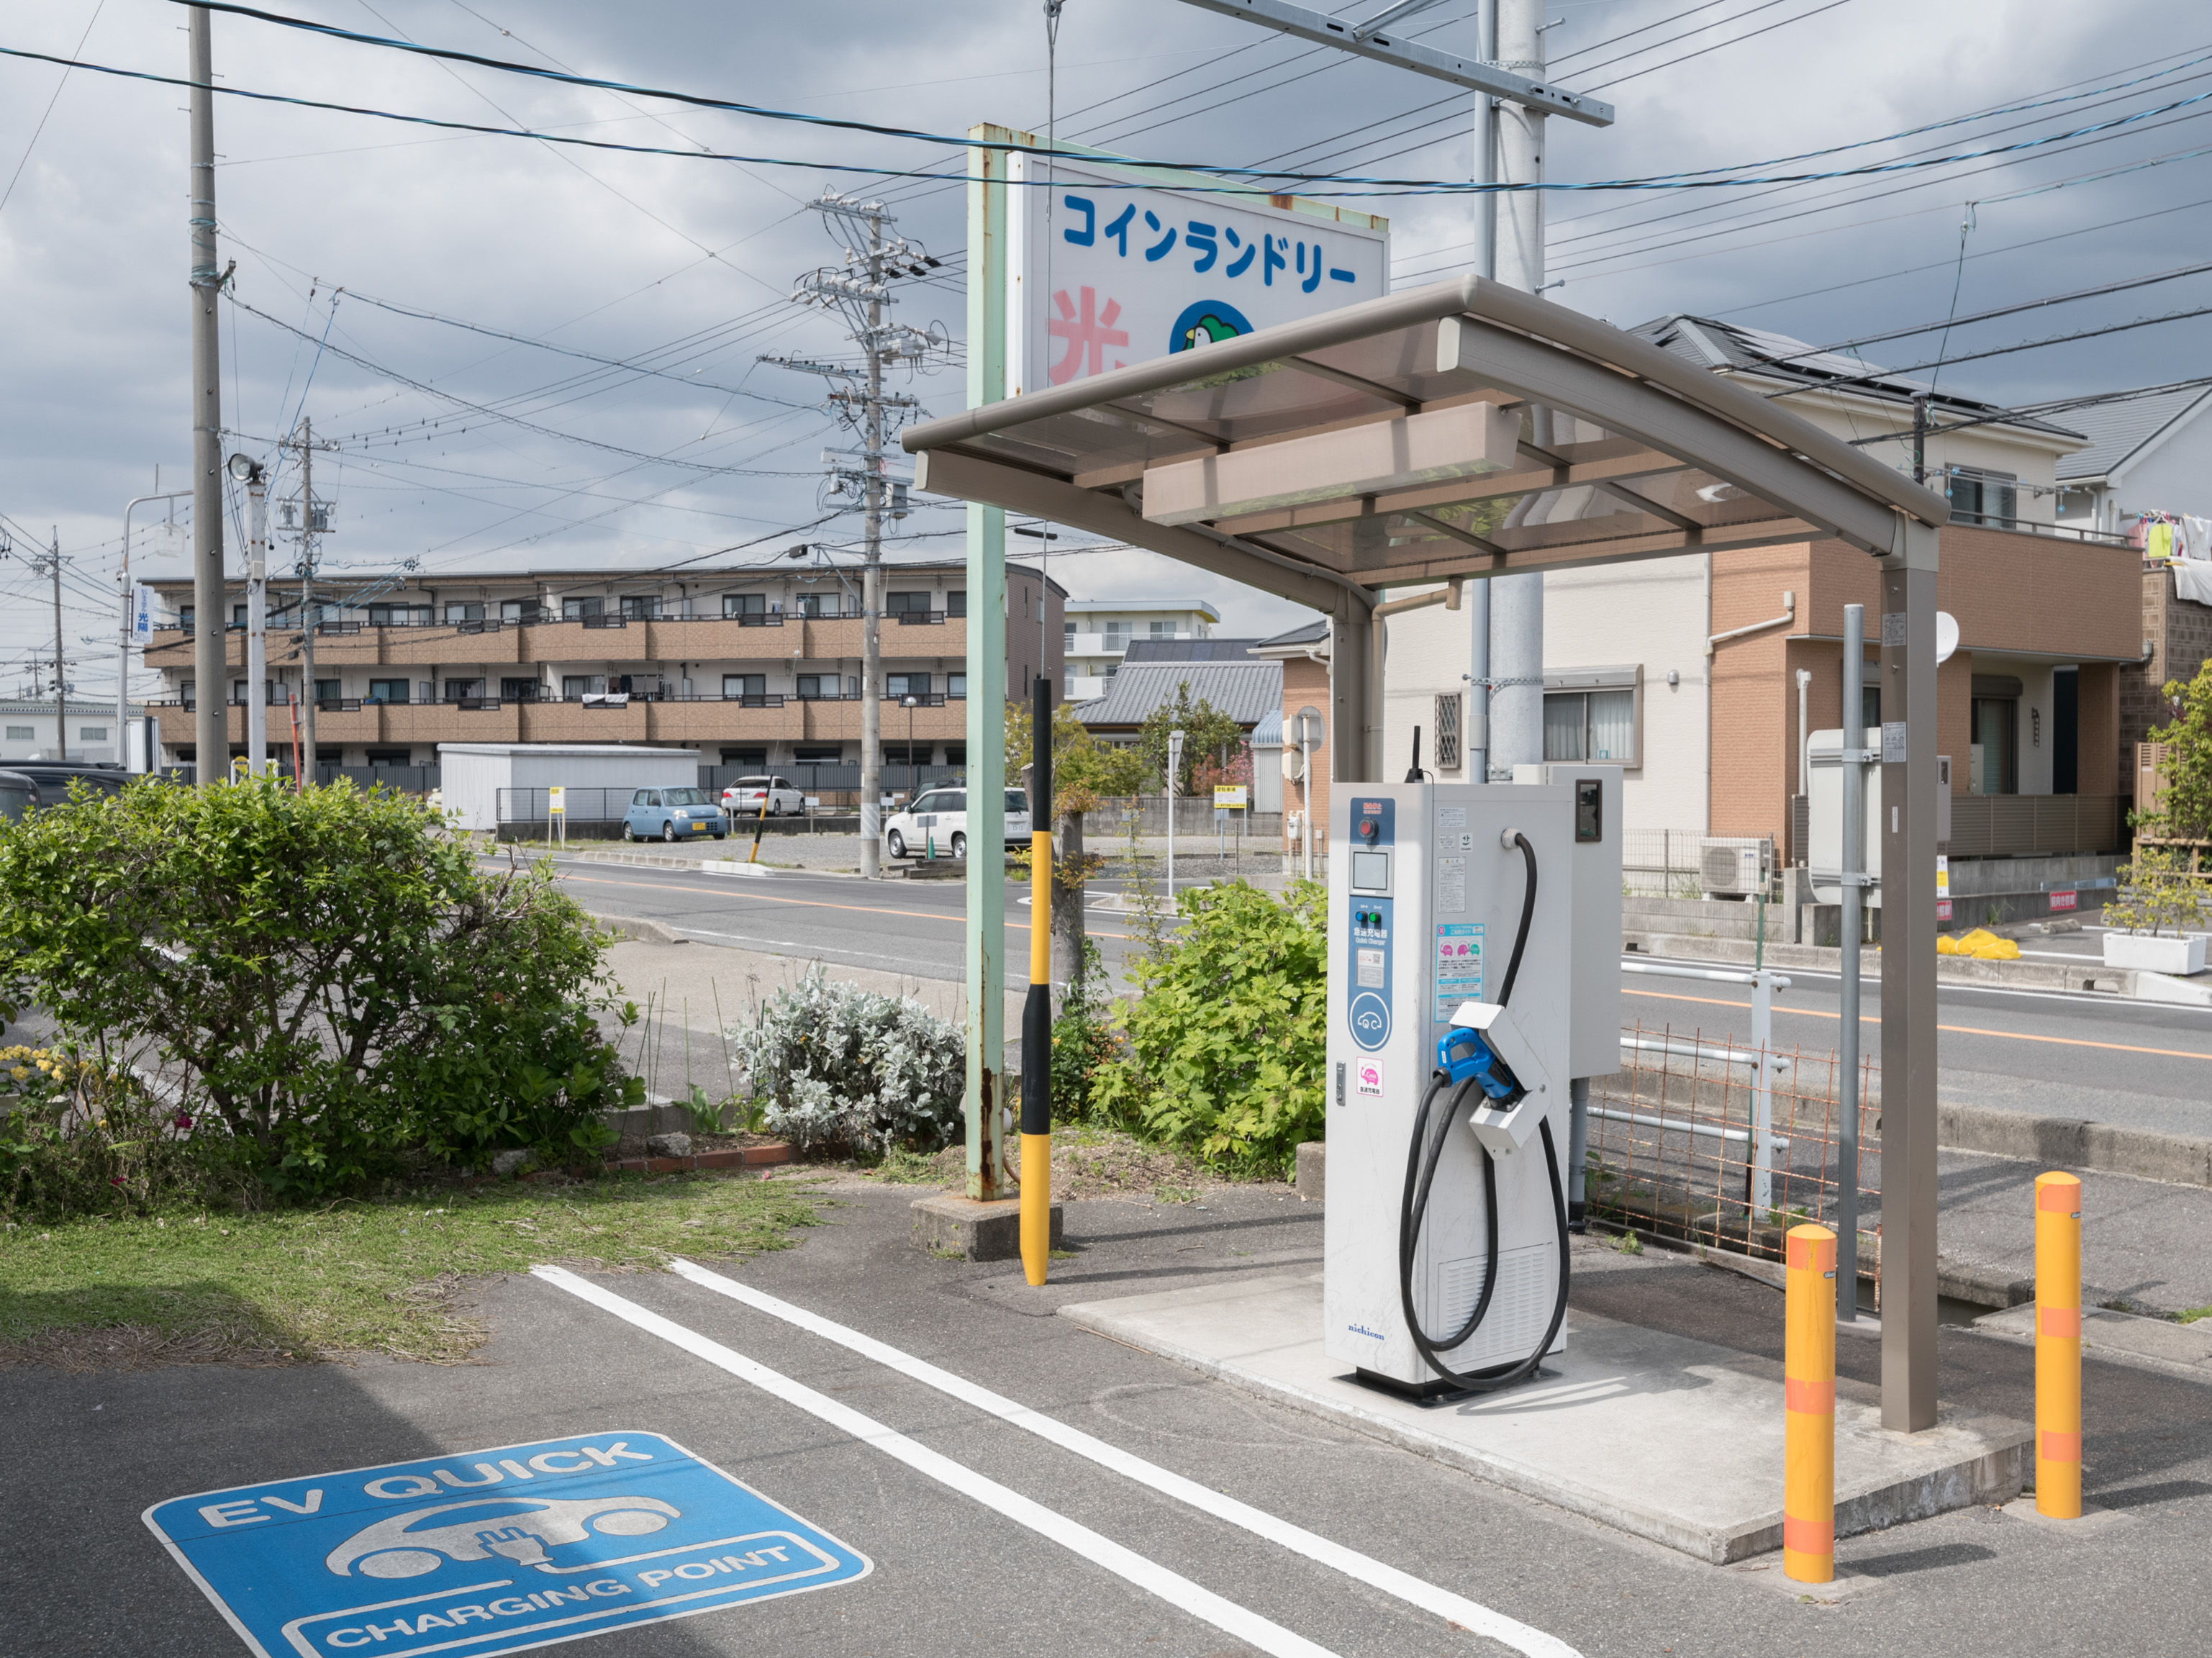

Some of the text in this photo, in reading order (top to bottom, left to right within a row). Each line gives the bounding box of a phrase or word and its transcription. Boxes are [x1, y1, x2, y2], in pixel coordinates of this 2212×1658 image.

[1064, 194, 1356, 294] コインランドリー
[137, 612, 149, 633] 光陽
[1354, 927, 1387, 938] 急速充電器
[1348, 1323, 1385, 1341] nichicon
[198, 1441, 653, 1528] EV QUICK
[325, 1546, 791, 1648] CHARGING POINT
